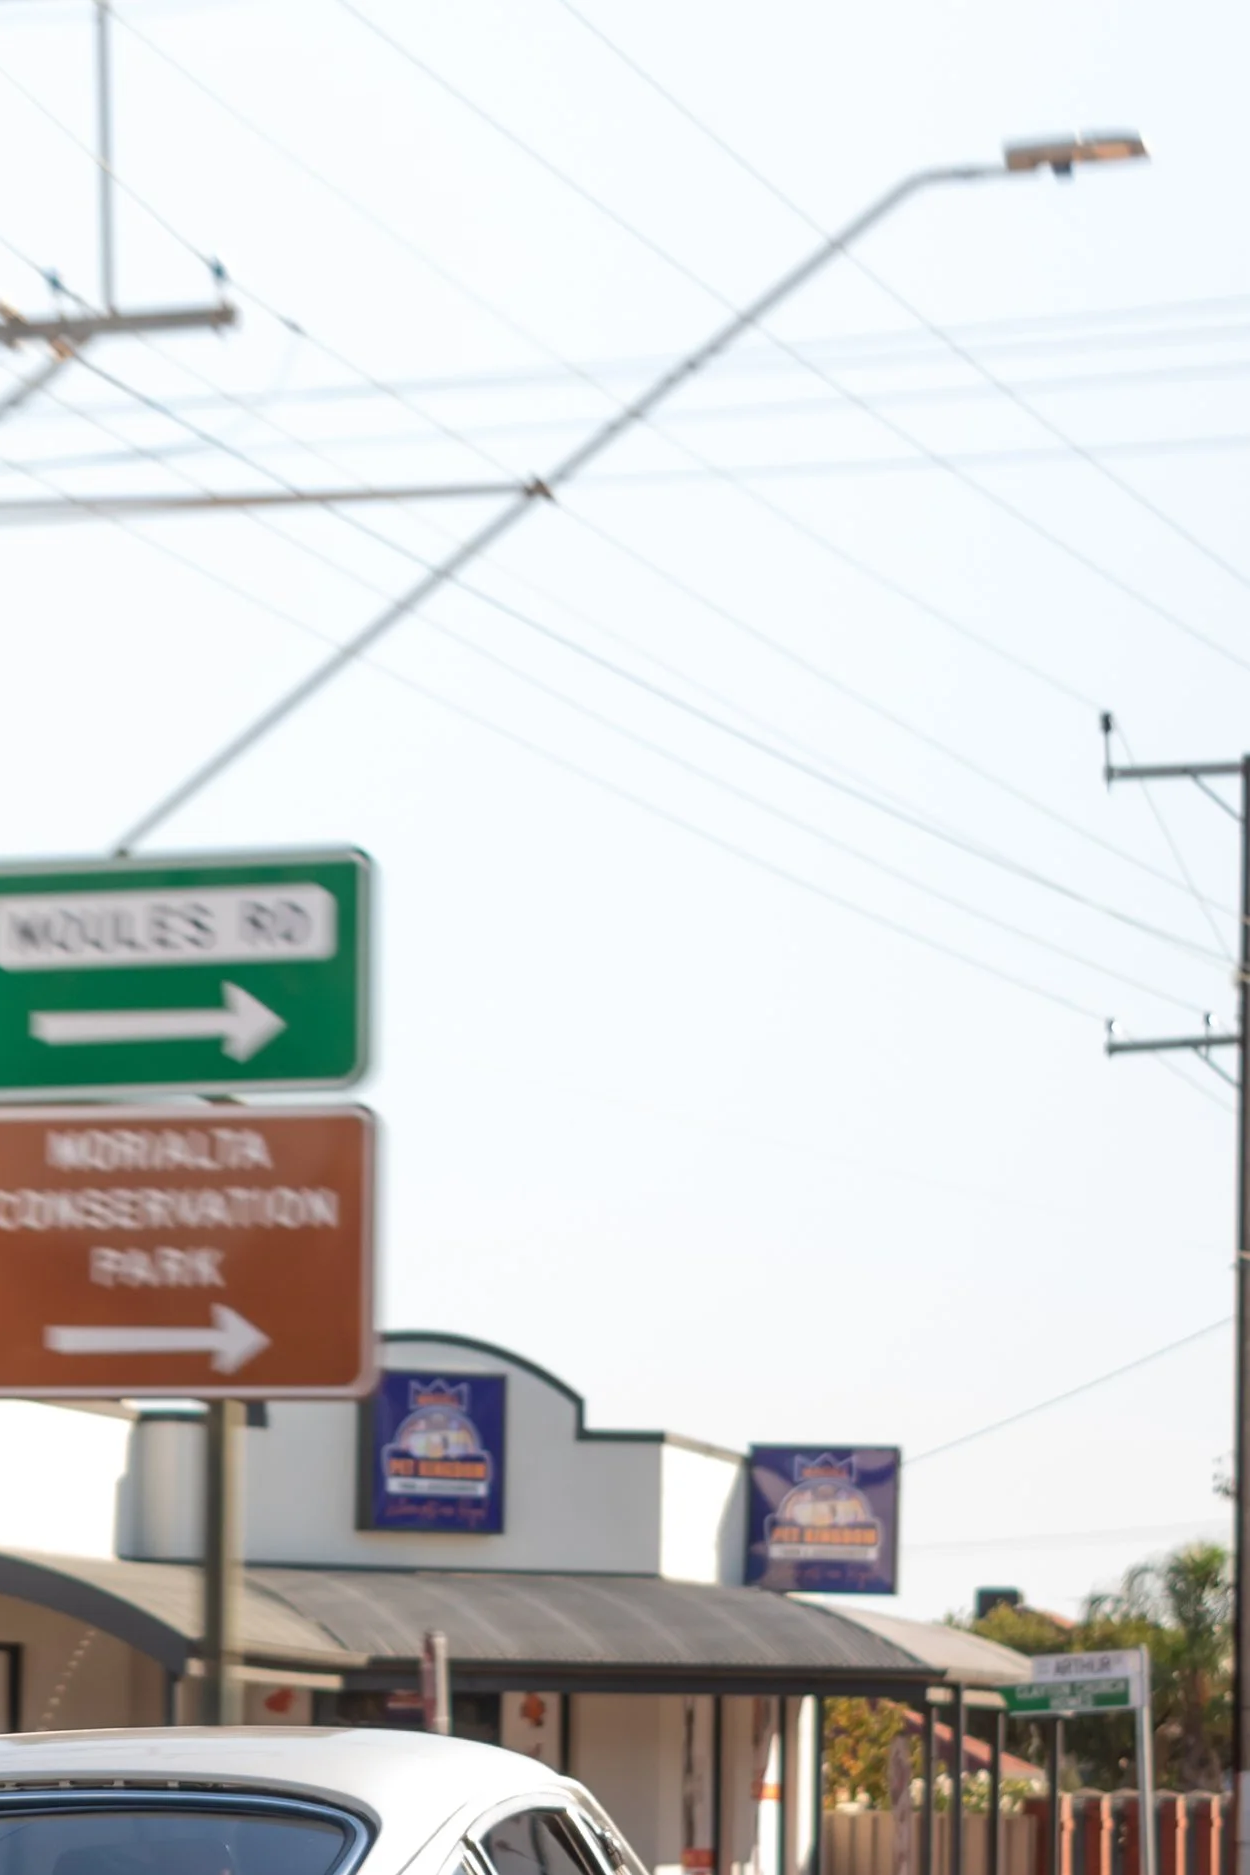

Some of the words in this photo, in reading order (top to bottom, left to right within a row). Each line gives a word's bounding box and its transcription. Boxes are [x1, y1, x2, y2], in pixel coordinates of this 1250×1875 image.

[238, 899, 313, 946] RD
[45, 1128, 273, 1172] MORIALTA
[88, 1244, 227, 1288] PARK
